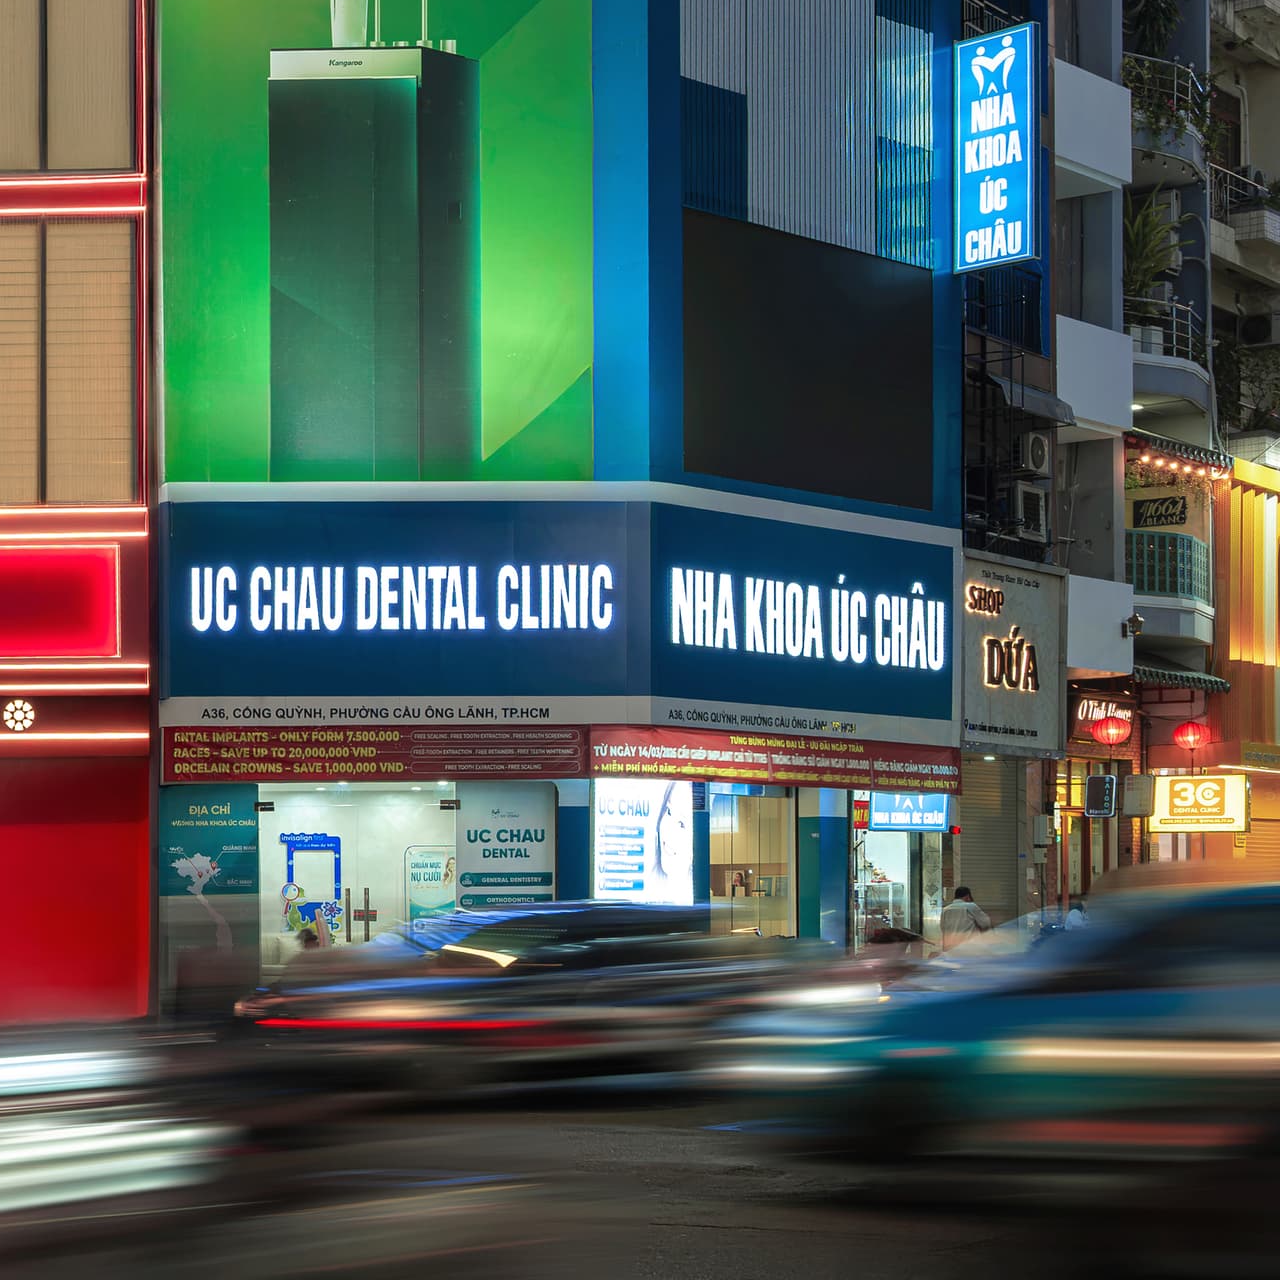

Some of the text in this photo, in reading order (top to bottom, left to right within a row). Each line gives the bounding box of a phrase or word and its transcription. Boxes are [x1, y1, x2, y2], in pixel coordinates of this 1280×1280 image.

[329, 59, 363, 67] Kangaroo
[964, 128, 1022, 175] KHOA
[979, 174, 1008, 214] ÚC
[964, 219, 1022, 264] CHÂU
[1146, 515, 1185, 527] BLANC
[190, 564, 615, 632] UC CHAU DENTAL CLINIC
[967, 585, 1004, 616] SHOP
[670, 566, 945, 671] NHA KHOA ÚC CHÂU
[984, 624, 1040, 692] DỨA
[202, 707, 229, 721] A36,
[233, 705, 272, 719] CỐNG
[329, 705, 389, 719] PHƯỜNG
[424, 705, 455, 719] ÔNG
[458, 705, 498, 720] LÃNH,
[501, 707, 550, 719] TP.HCM
[212, 731, 400, 742] IMPLANTS ONLY FORM 7.500.000
[220, 746, 377, 759] SAVE UP TO 20,000,000 VND
[232, 762, 283, 773] CROWNS
[293, 762, 322, 773] SAVE
[324, 762, 377, 774] 1,000,000
[379, 761, 404, 772] VND
[1173, 781, 1221, 807] 3C
[189, 805, 208, 817] ĐỊA
[599, 797, 650, 817] UC CHAU
[281, 834, 313, 842] invisalign
[466, 829, 545, 843] UC CHAU
[482, 848, 530, 858] DENTAL
